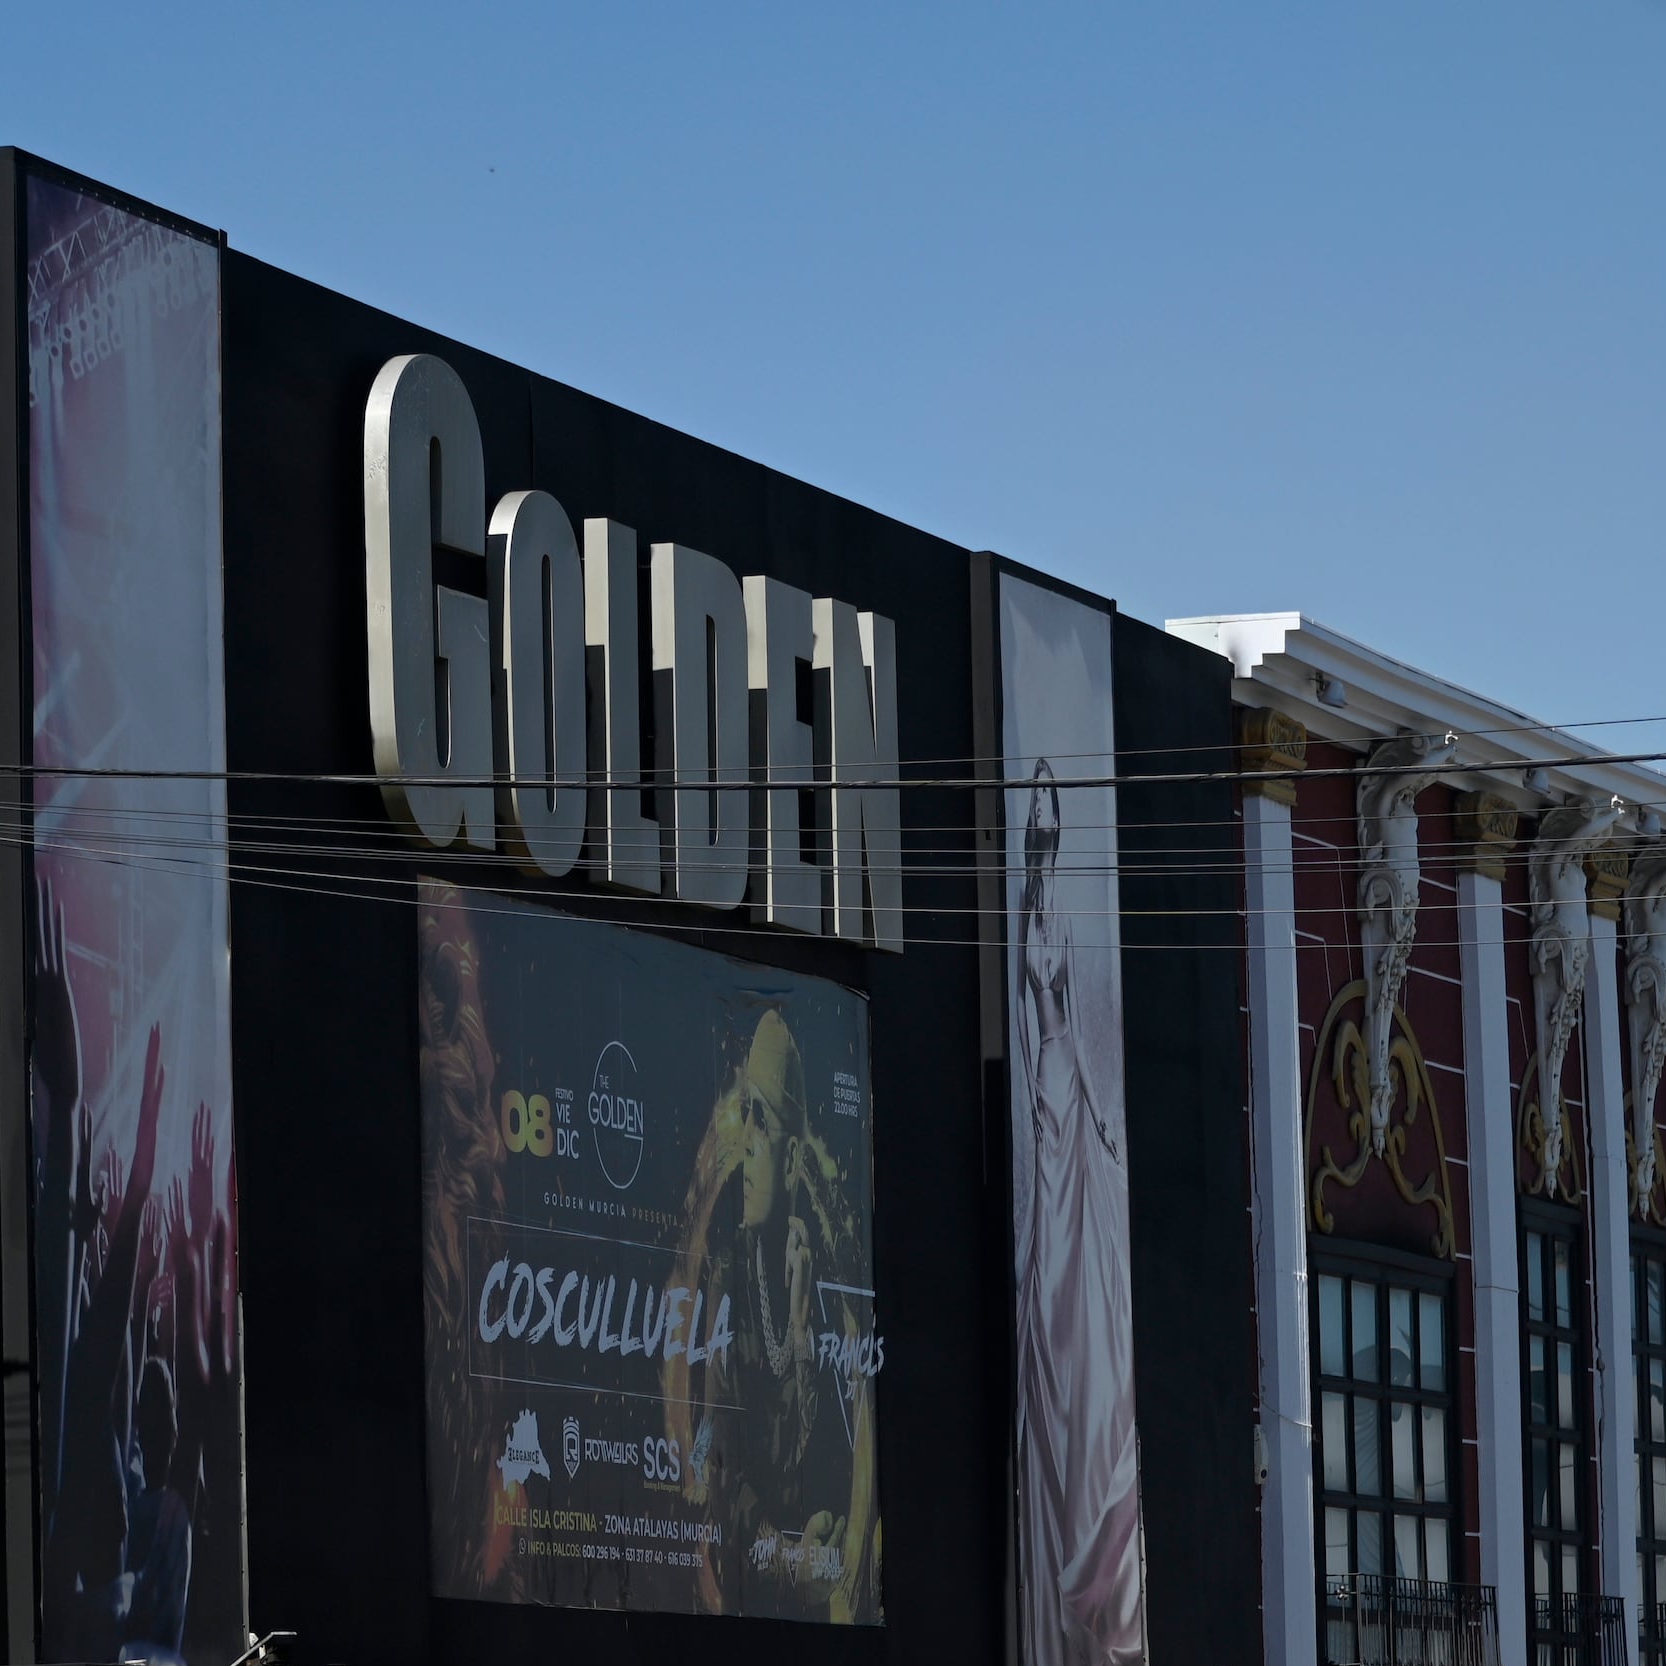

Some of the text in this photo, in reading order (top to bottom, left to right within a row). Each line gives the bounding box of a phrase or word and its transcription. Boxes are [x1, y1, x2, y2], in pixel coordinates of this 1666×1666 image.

[364, 354, 904, 953] GOLDEN
[555, 1087, 574, 1102] FESTIVO
[556, 1102, 571, 1124] VIE
[588, 1091, 644, 1134] GOLDEN
[501, 1089, 554, 1157] 08
[557, 1127, 580, 1160] DIC
[543, 1191, 679, 1227] GOLDEN MURCIA PRESENTA
[478, 1249, 735, 1377] COSCULLUELA
[643, 1435, 681, 1482] SCS
[497, 1505, 722, 1547] CALLE ISLA CRISTINA ZONA ATALAYAS (MURCIA)
[527, 1541, 545, 1555] INFO
[546, 1543, 552, 1556] &
[552, 1543, 582, 1558] PALCOS:
[582, 1544, 596, 1559] 600
[596, 1545, 609, 1560] 296
[609, 1545, 621, 1561] 194
[645, 1549, 653, 1563] 87
[654, 1549, 663, 1564] 40
[679, 1553, 691, 1567] 039
